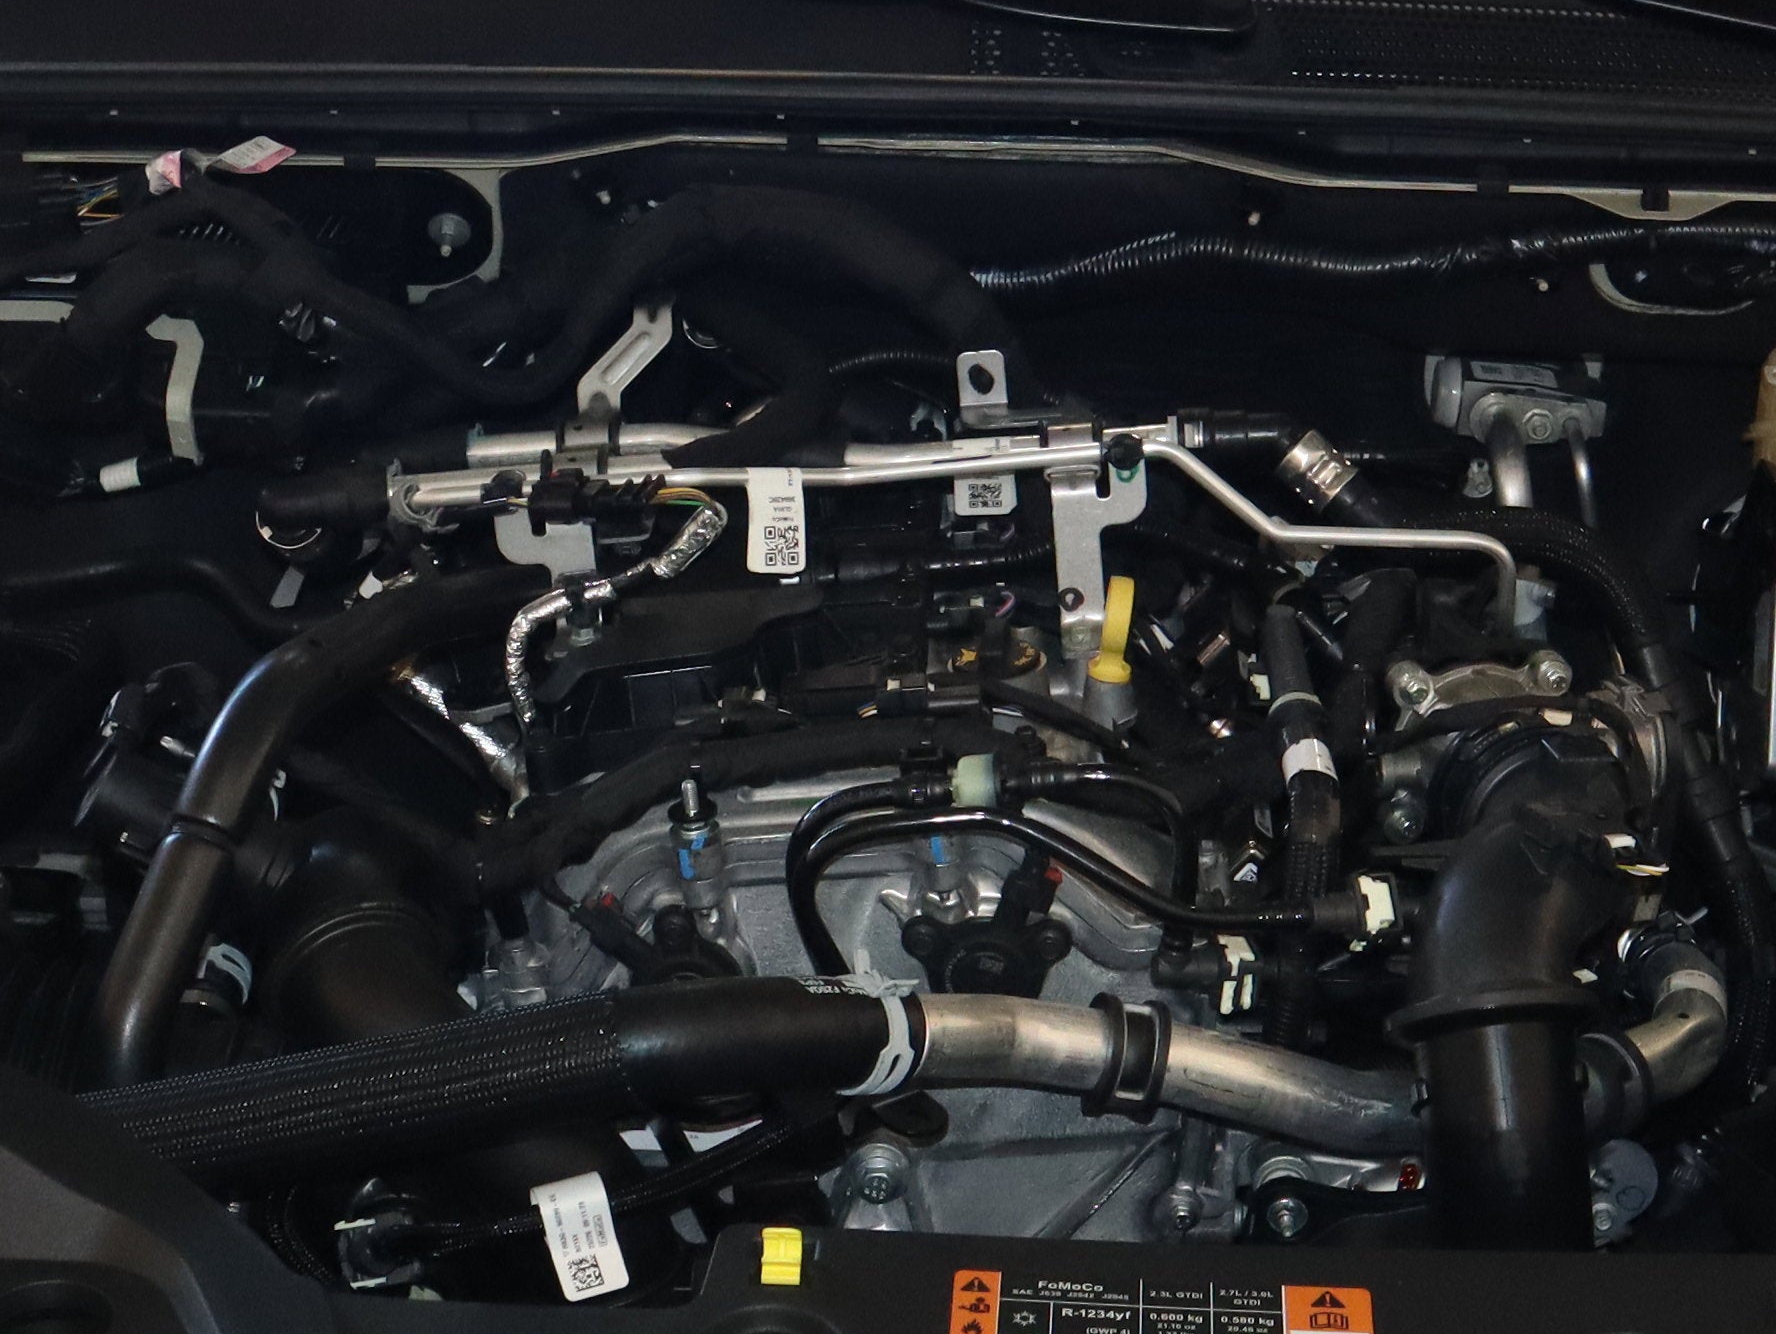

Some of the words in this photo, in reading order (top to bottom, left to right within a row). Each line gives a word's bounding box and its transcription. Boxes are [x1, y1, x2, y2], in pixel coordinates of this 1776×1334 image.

[1038, 1280, 1104, 1292] FoMoCo
[1061, 1308, 1132, 1321] R-1234yf
[1187, 1314, 1203, 1324] kg
[1258, 1317, 1275, 1327] kg
[1086, 1327, 1117, 1334] (GWP
